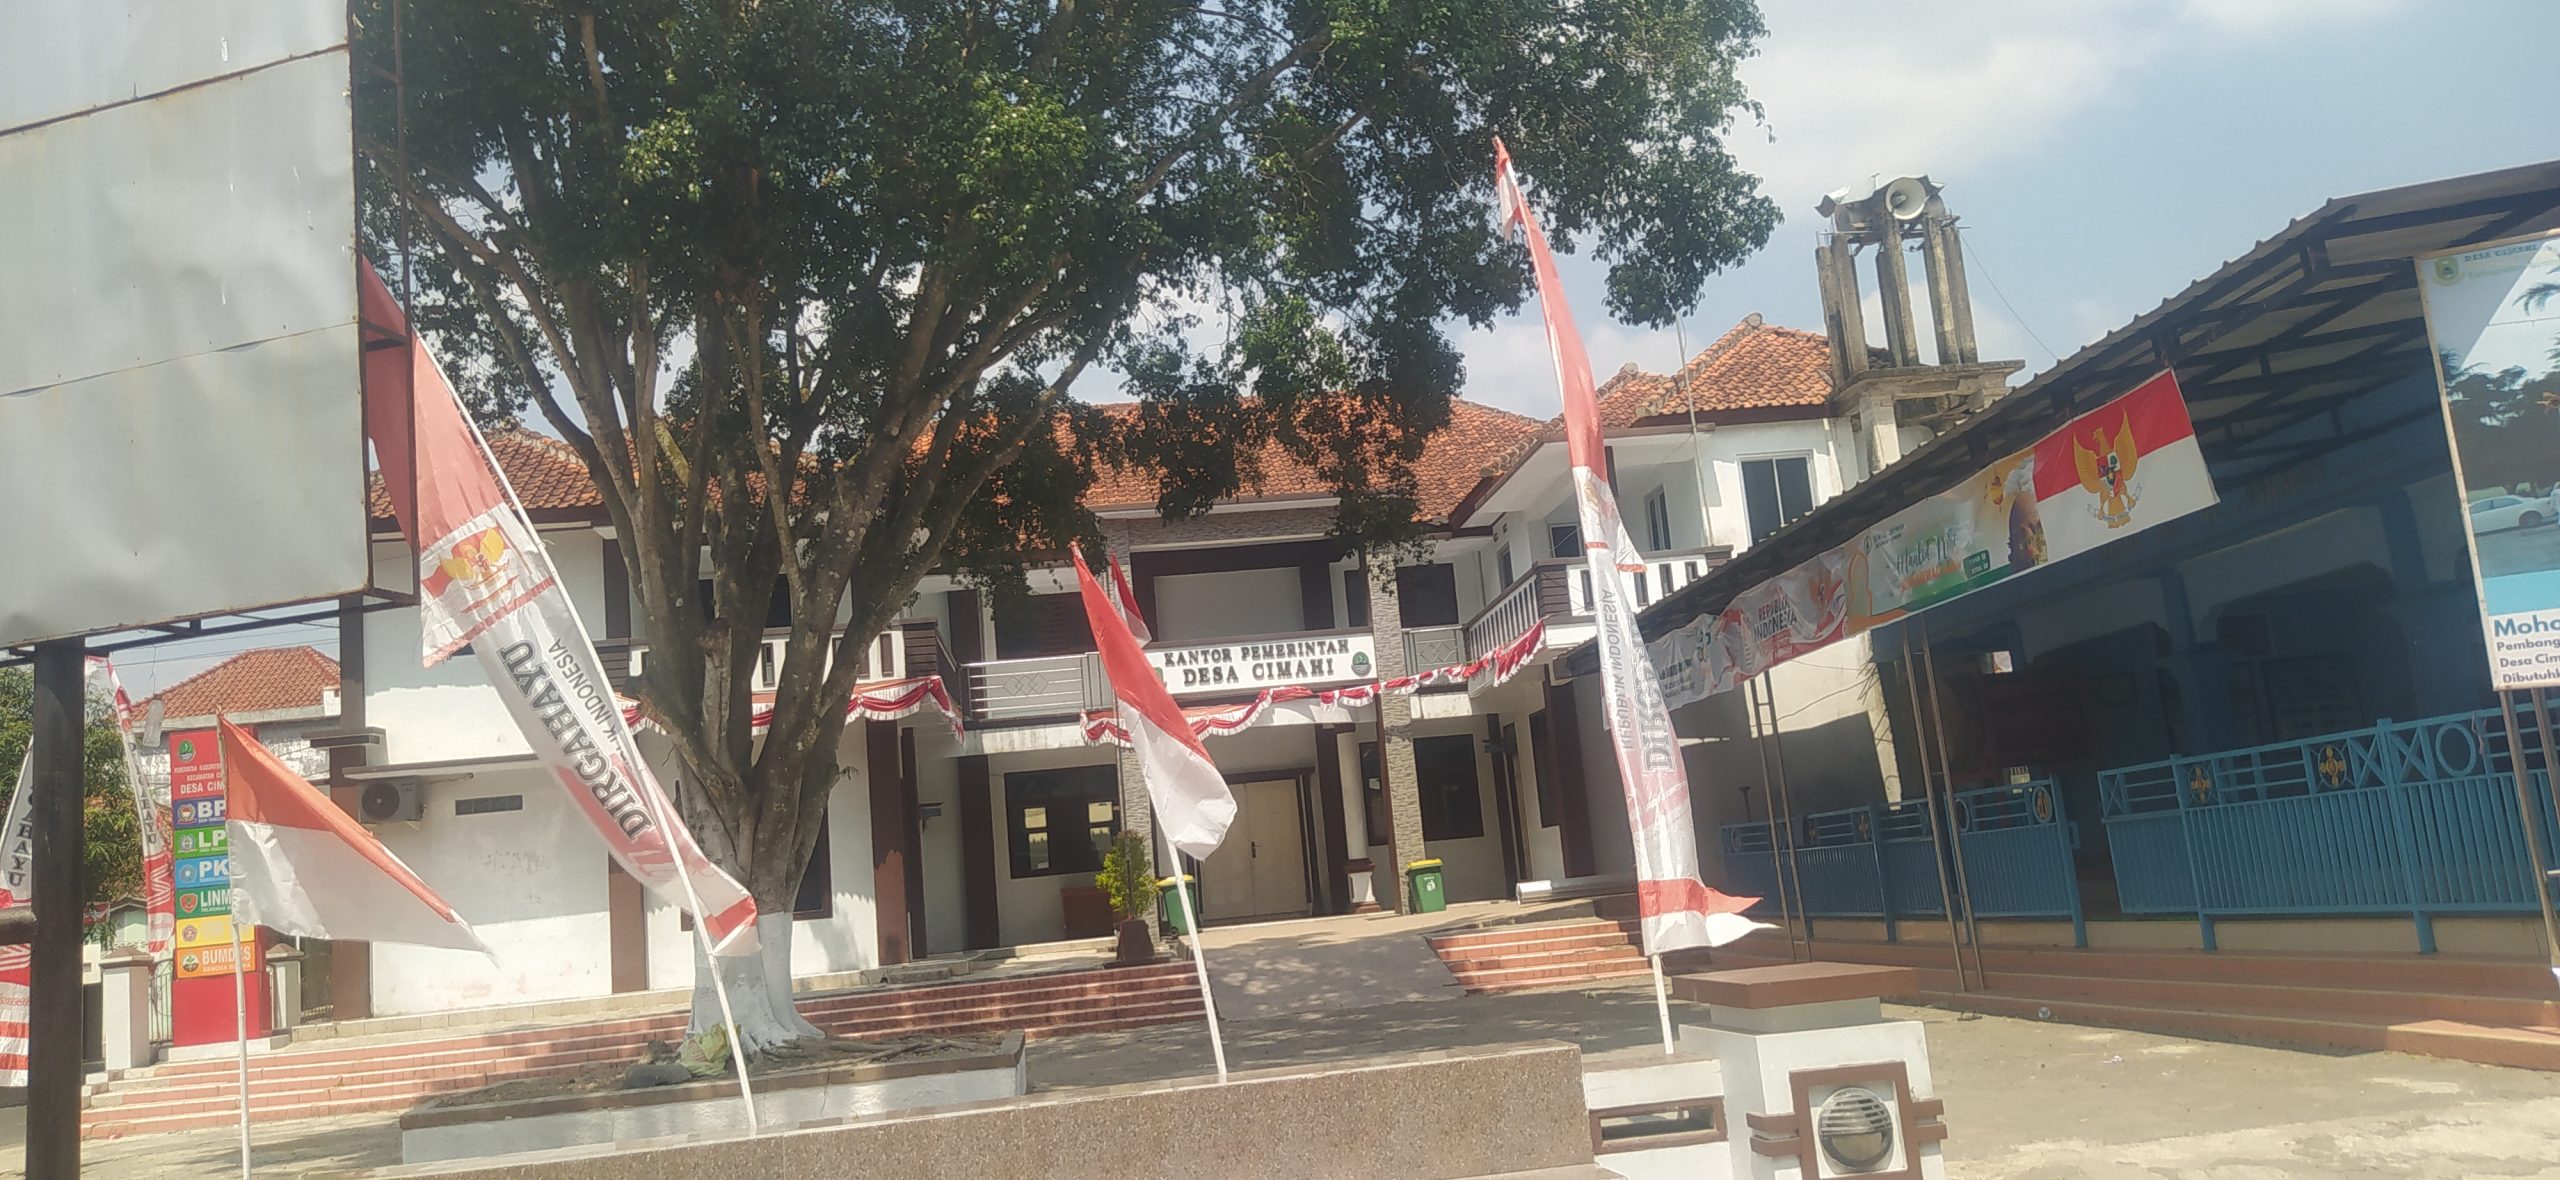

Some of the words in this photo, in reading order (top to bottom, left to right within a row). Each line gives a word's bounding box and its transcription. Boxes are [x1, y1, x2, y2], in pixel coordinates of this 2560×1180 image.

[1164, 648, 1233, 667] KANTOR
[1241, 639, 1349, 661] PEMERINTAH
[2500, 658, 2532, 667] Desa
[1183, 665, 1239, 686] DESA
[1252, 657, 1334, 681] CIMAHI
[548, 638, 613, 725] INDONESIA
[498, 639, 655, 842] DIRGAHAYU
[181, 782, 204, 794] DESA
[207, 780, 226, 792] CIM
[197, 801, 226, 818] BP
[198, 829, 228, 848] LP
[200, 859, 230, 878] PK
[201, 889, 233, 907] LINM
[202, 946, 251, 965] BUMDS
